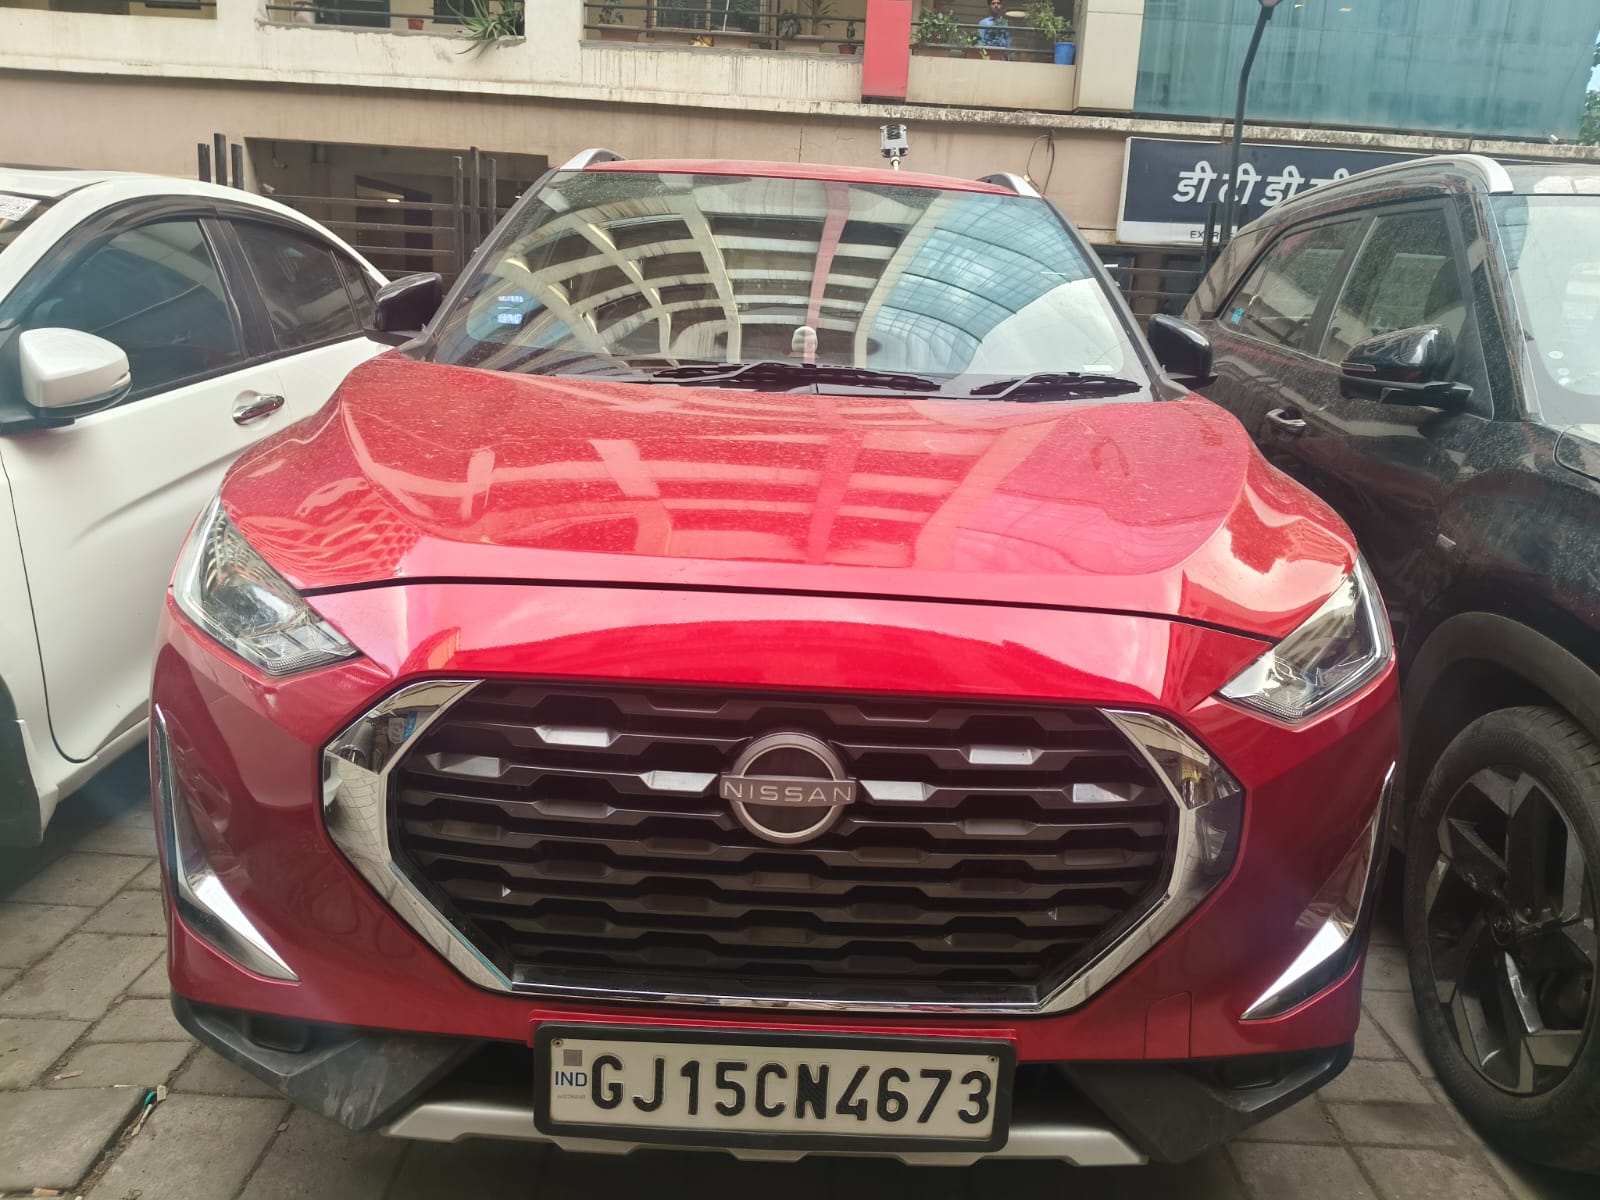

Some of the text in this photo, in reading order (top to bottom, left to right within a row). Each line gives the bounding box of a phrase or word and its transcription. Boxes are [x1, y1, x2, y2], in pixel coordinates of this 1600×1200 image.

[723, 780, 851, 802] NISSAN
[555, 1054, 992, 1124] IND GJ15CN4673
